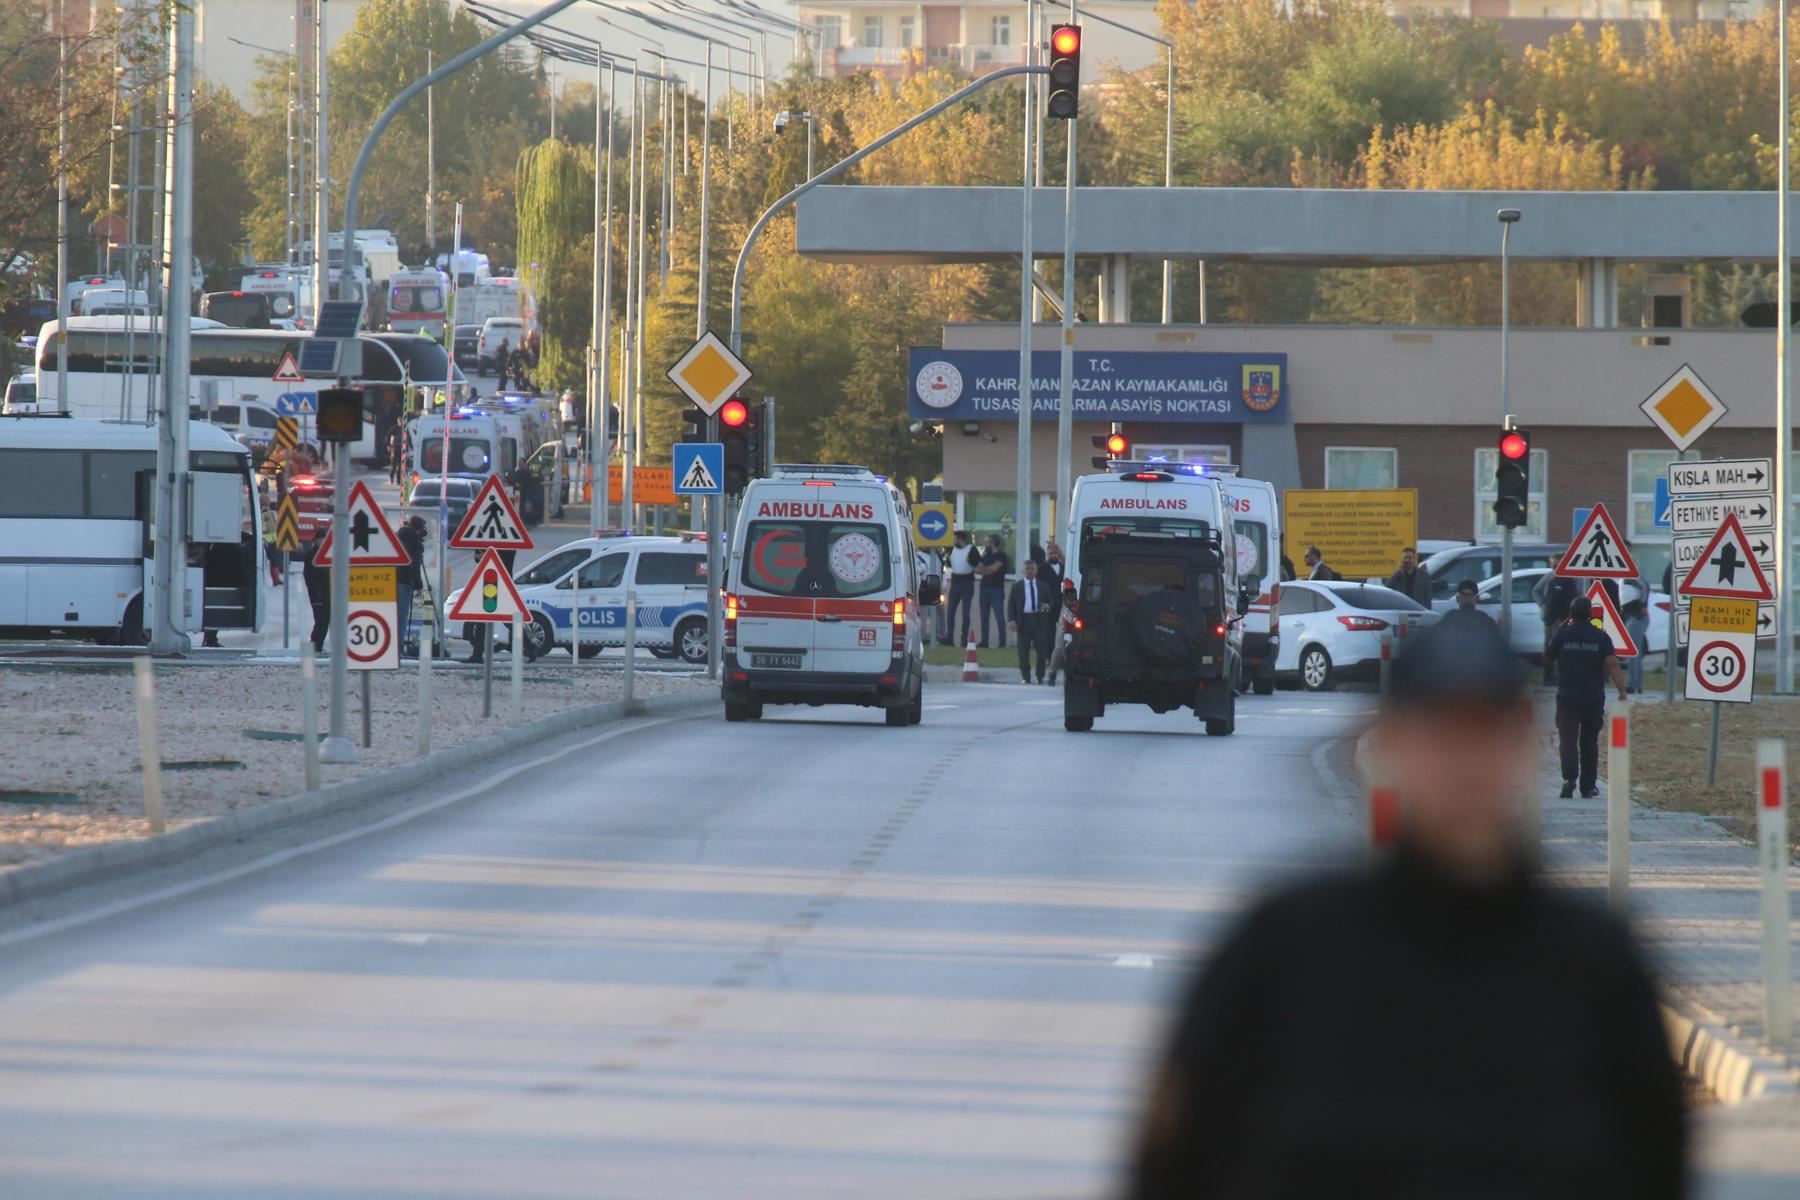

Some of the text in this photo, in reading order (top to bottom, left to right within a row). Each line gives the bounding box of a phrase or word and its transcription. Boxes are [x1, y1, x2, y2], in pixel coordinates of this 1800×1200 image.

[1089, 359, 1115, 372] T.C.
[975, 377, 1228, 393] KAHRMANAZAN KAYMAKAMLIĞI
[972, 398, 1020, 414] TUSAŞ
[1110, 396, 1163, 415] ASAYİŞ
[1167, 399, 1231, 413] NOKTASI
[1674, 469, 1746, 488] KIŞLA MAH.
[757, 502, 874, 520] AMBULANS
[1100, 498, 1188, 510] AMBULANS
[1697, 606, 1752, 617] AZAMİ HIZ
[1703, 616, 1745, 625] BÖLGESİ
[350, 624, 379, 646] 30
[861, 630, 874, 640] 112
[1705, 655, 1735, 677] 30
